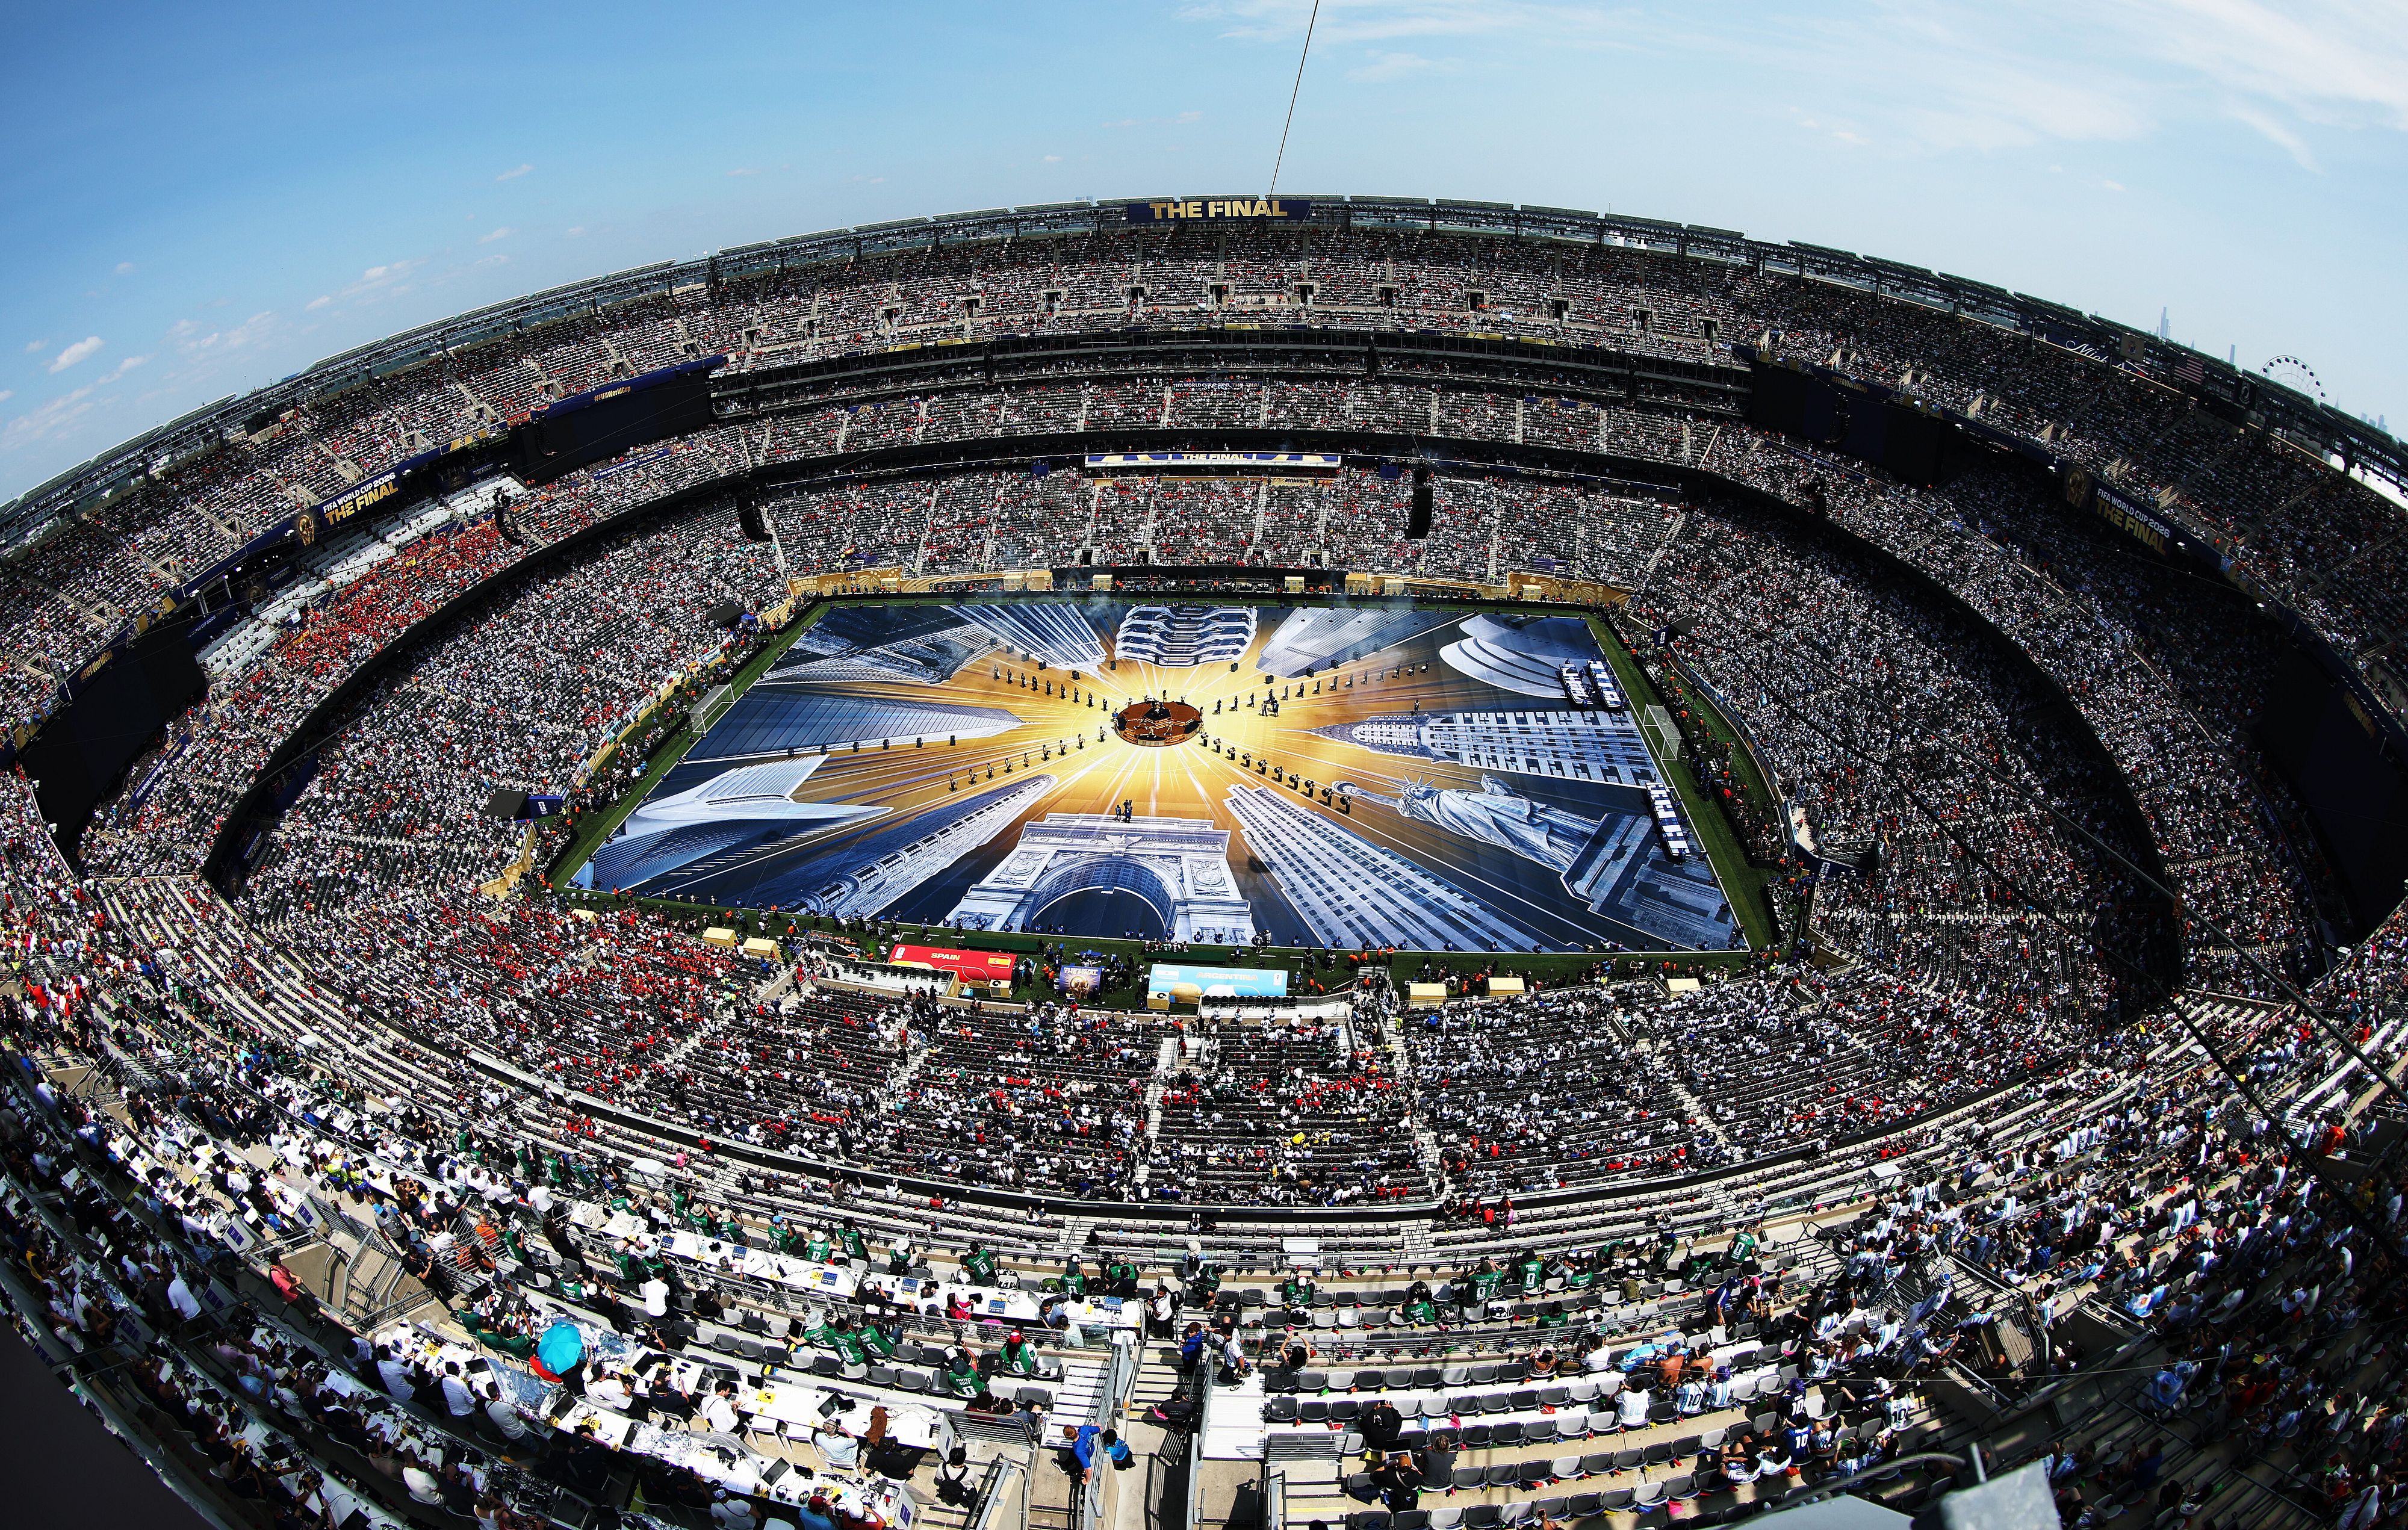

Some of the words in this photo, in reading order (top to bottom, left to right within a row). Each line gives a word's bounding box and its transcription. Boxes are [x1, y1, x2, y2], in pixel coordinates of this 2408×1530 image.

[1149, 202, 1203, 219] THE
[1208, 200, 1288, 218] FINAL
[1674, 355, 1699, 364] JERSEY
[594, 385, 631, 402] #FIFAWorldCup
[323, 503, 338, 513] FIFA
[337, 489, 360, 505] WORLD
[361, 483, 373, 494] CUP
[373, 472, 396, 488] 2026
[325, 501, 355, 525] THE
[355, 481, 399, 511] FINAL
[2097, 488, 2111, 502] FIFA
[2111, 495, 2135, 516] WORLD
[2135, 509, 2148, 524] CUP
[2148, 518, 2170, 539] 2026
[2096, 497, 2123, 528] THE
[2124, 515, 2167, 554] FINAL
[80, 649, 113, 684] #FIFAWorldCup
[142, 779, 153, 791] WORLD
[930, 952, 961, 961] SPAIN
[1196, 971, 1258, 981] ARGENTINA
[1690, 1394, 1704, 1407] 10
[1792, 1398, 1805, 1416] 10
[585, 1418, 596, 1426] 46
[1892, 1408, 1907, 1424] 10
[1795, 1432, 1809, 1449] 10
